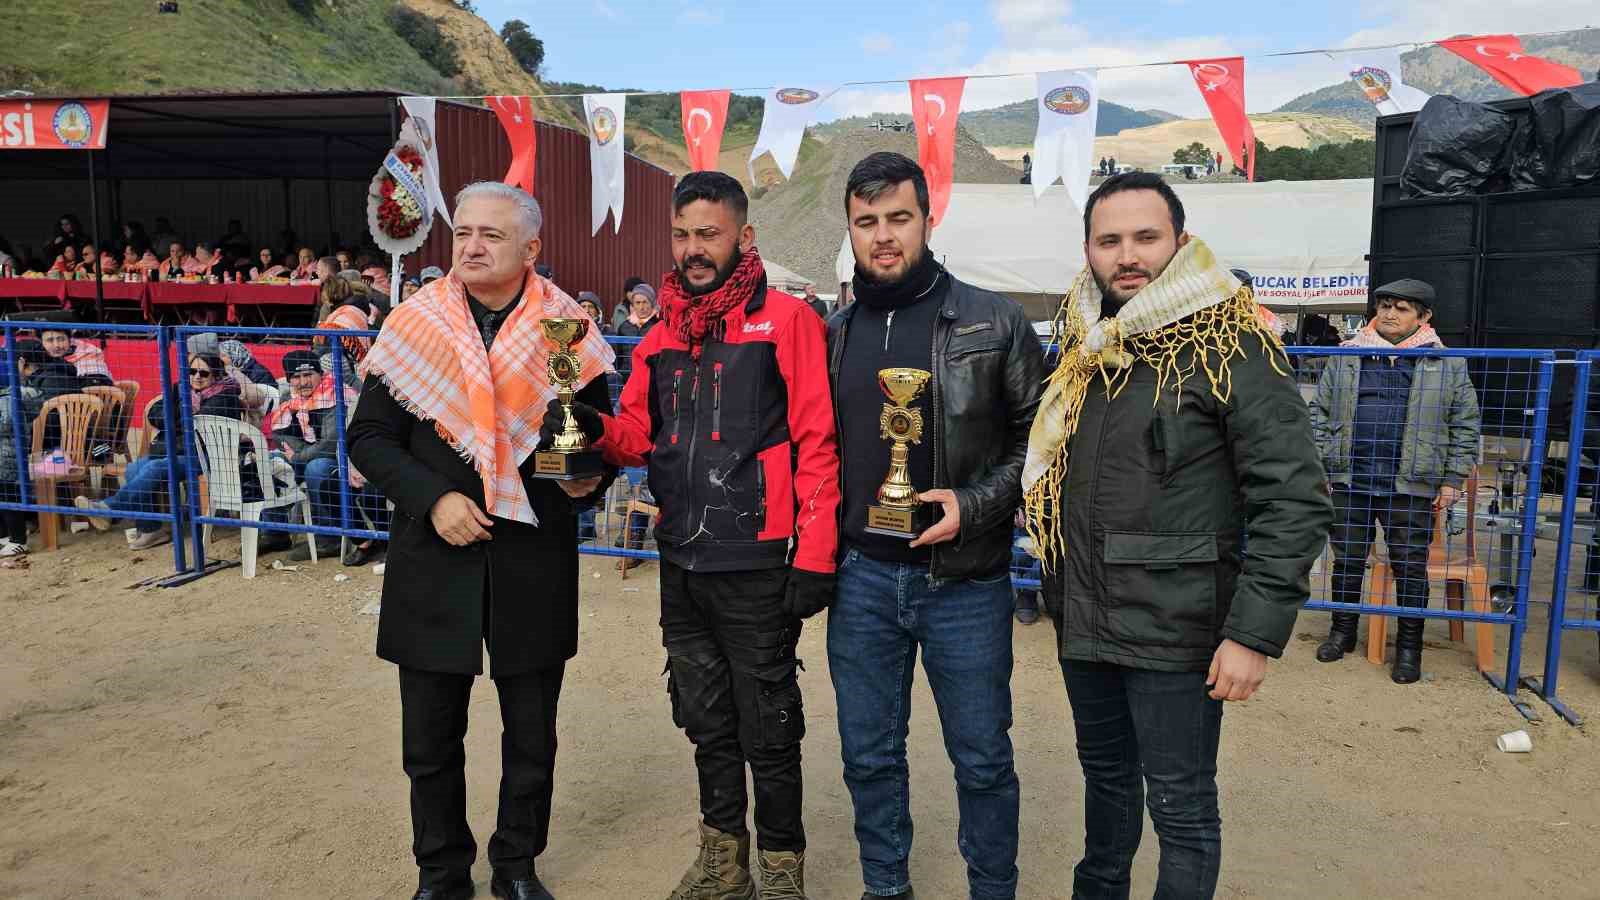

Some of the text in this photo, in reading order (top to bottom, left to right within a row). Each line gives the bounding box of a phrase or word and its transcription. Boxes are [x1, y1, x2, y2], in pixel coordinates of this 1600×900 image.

[0, 102, 36, 146] Sİ
[1270, 290, 1301, 298] SOSYAL
[1328, 287, 1369, 297] MÜDÜRL
